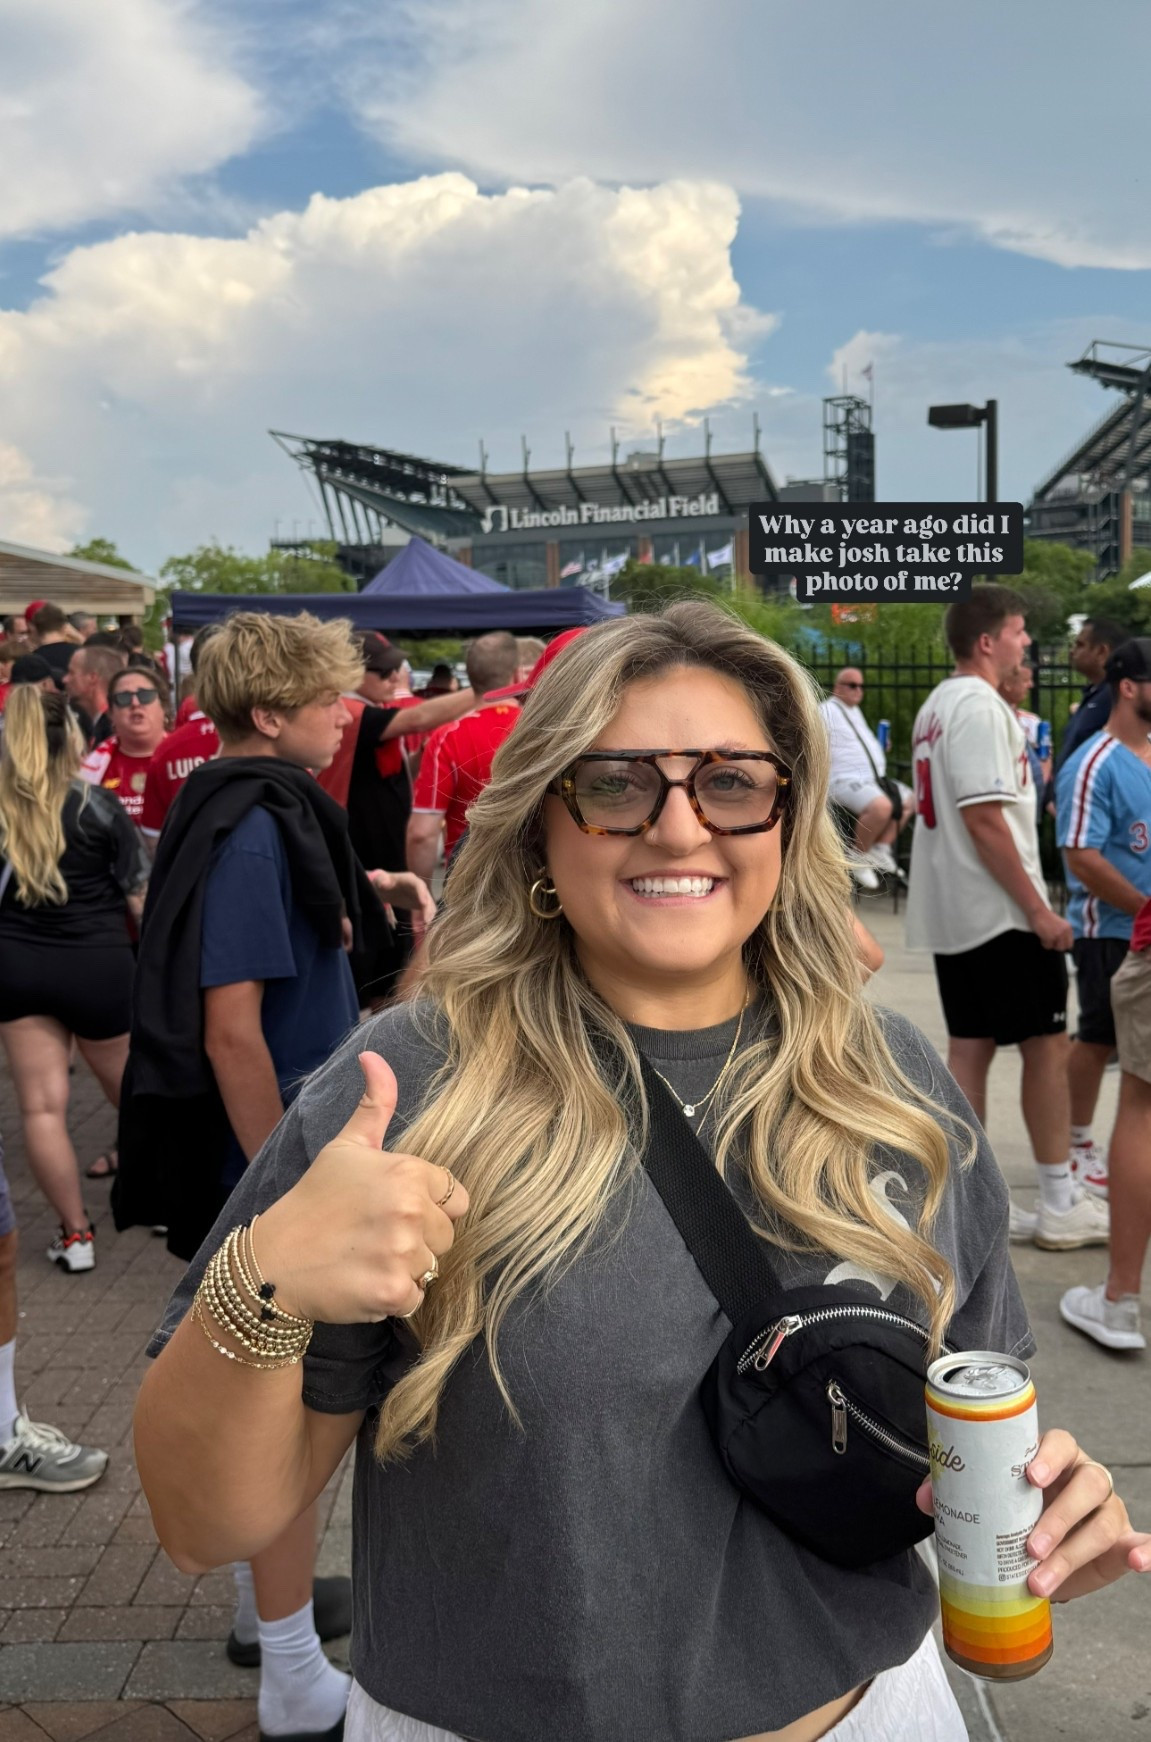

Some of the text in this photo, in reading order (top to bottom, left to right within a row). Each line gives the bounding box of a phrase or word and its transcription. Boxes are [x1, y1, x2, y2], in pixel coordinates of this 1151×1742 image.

[509, 492, 720, 529] Lincoln Financial Field
